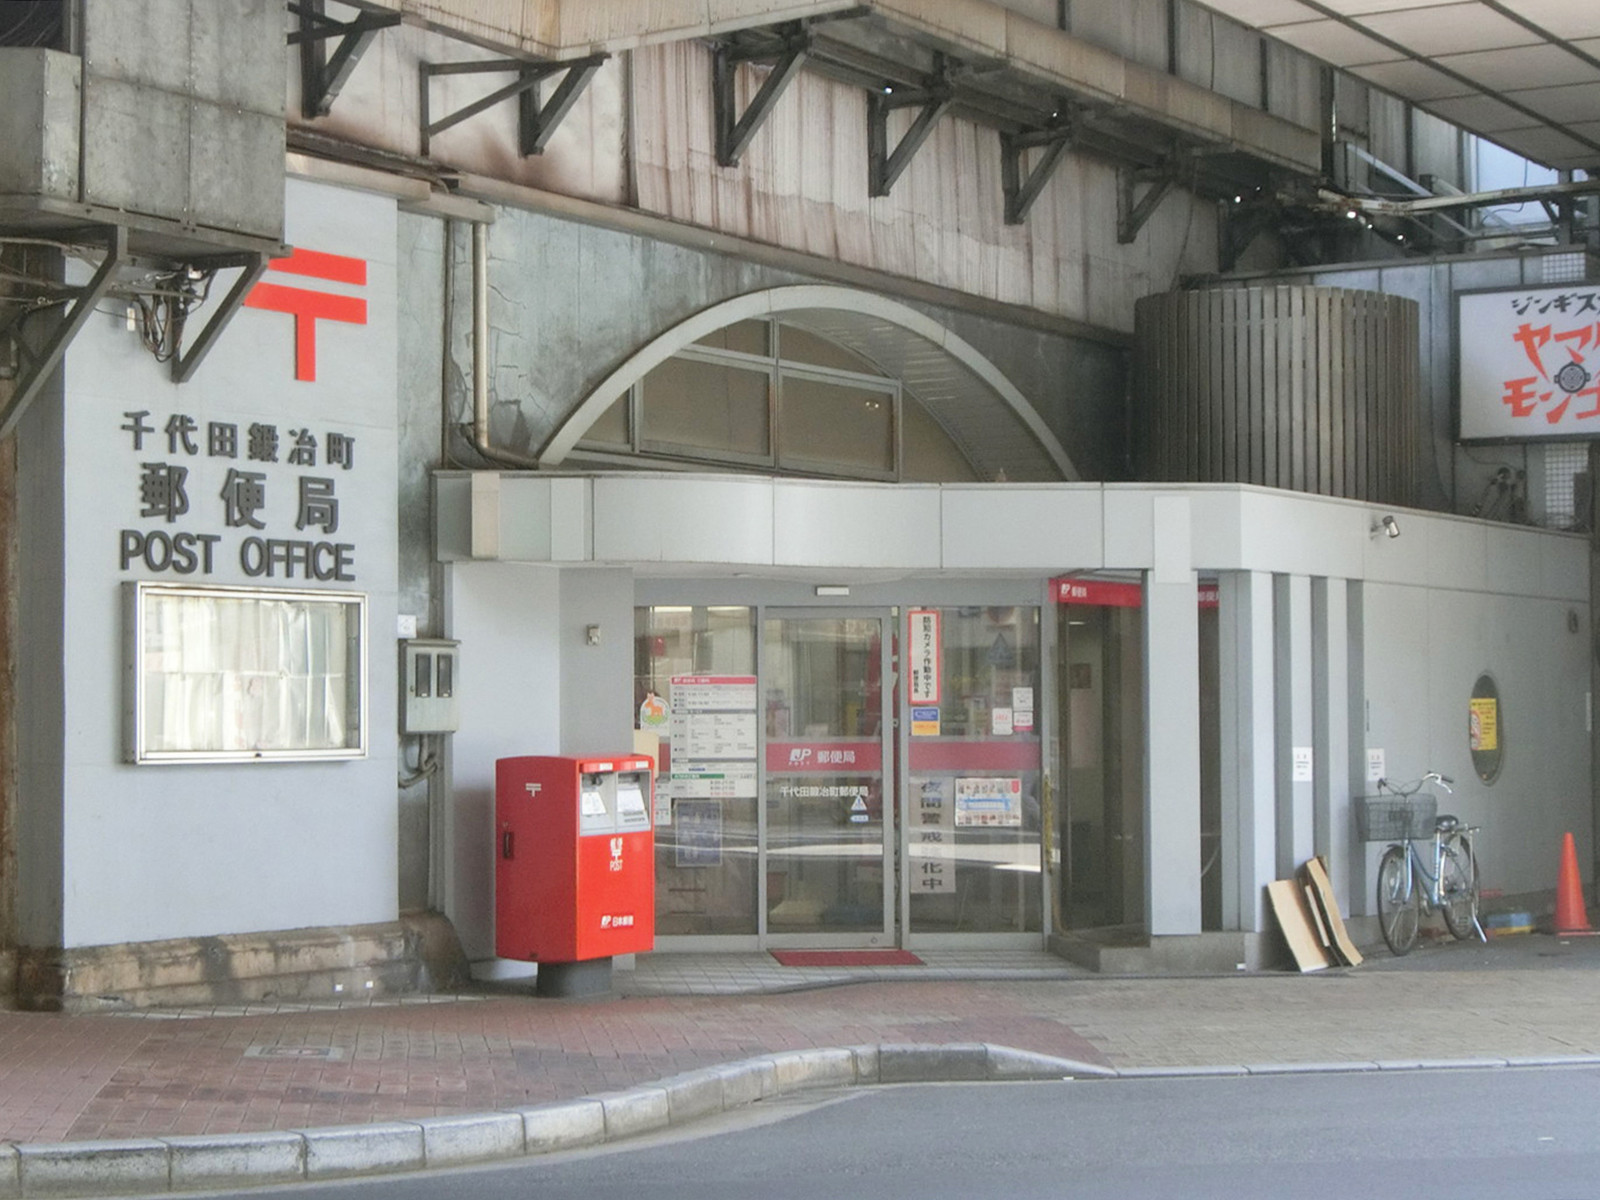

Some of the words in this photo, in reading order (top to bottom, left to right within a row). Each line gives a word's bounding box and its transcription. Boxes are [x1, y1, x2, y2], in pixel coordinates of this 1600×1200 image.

[1511, 293, 1600, 317] ジンギス
[1513, 321, 1600, 384] ヤマ
[121, 410, 355, 470] 千代田鍛冶町
[139, 462, 339, 534] 郵便局
[120, 529, 221, 575] POST
[241, 536, 356, 582] OFFICE
[817, 750, 856, 764] 郵便局
